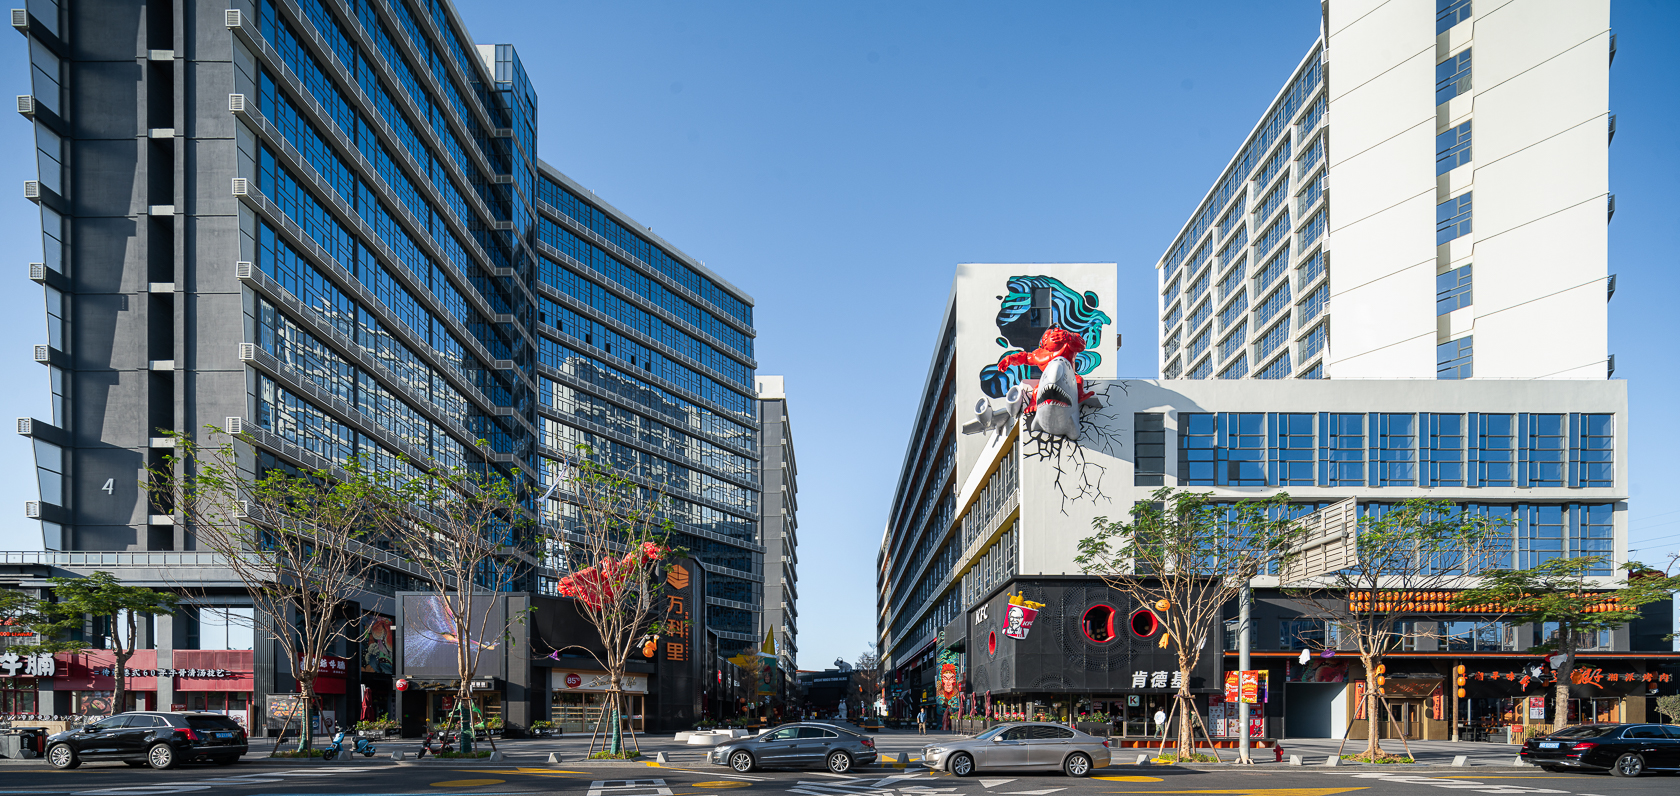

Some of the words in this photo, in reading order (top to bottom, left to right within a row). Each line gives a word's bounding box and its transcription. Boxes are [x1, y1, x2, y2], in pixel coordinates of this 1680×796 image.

[101, 478, 113, 494] 4
[975, 604, 988, 625] KFC
[667, 595, 683, 661] 万科里
[0, 651, 55, 676] 牛腩
